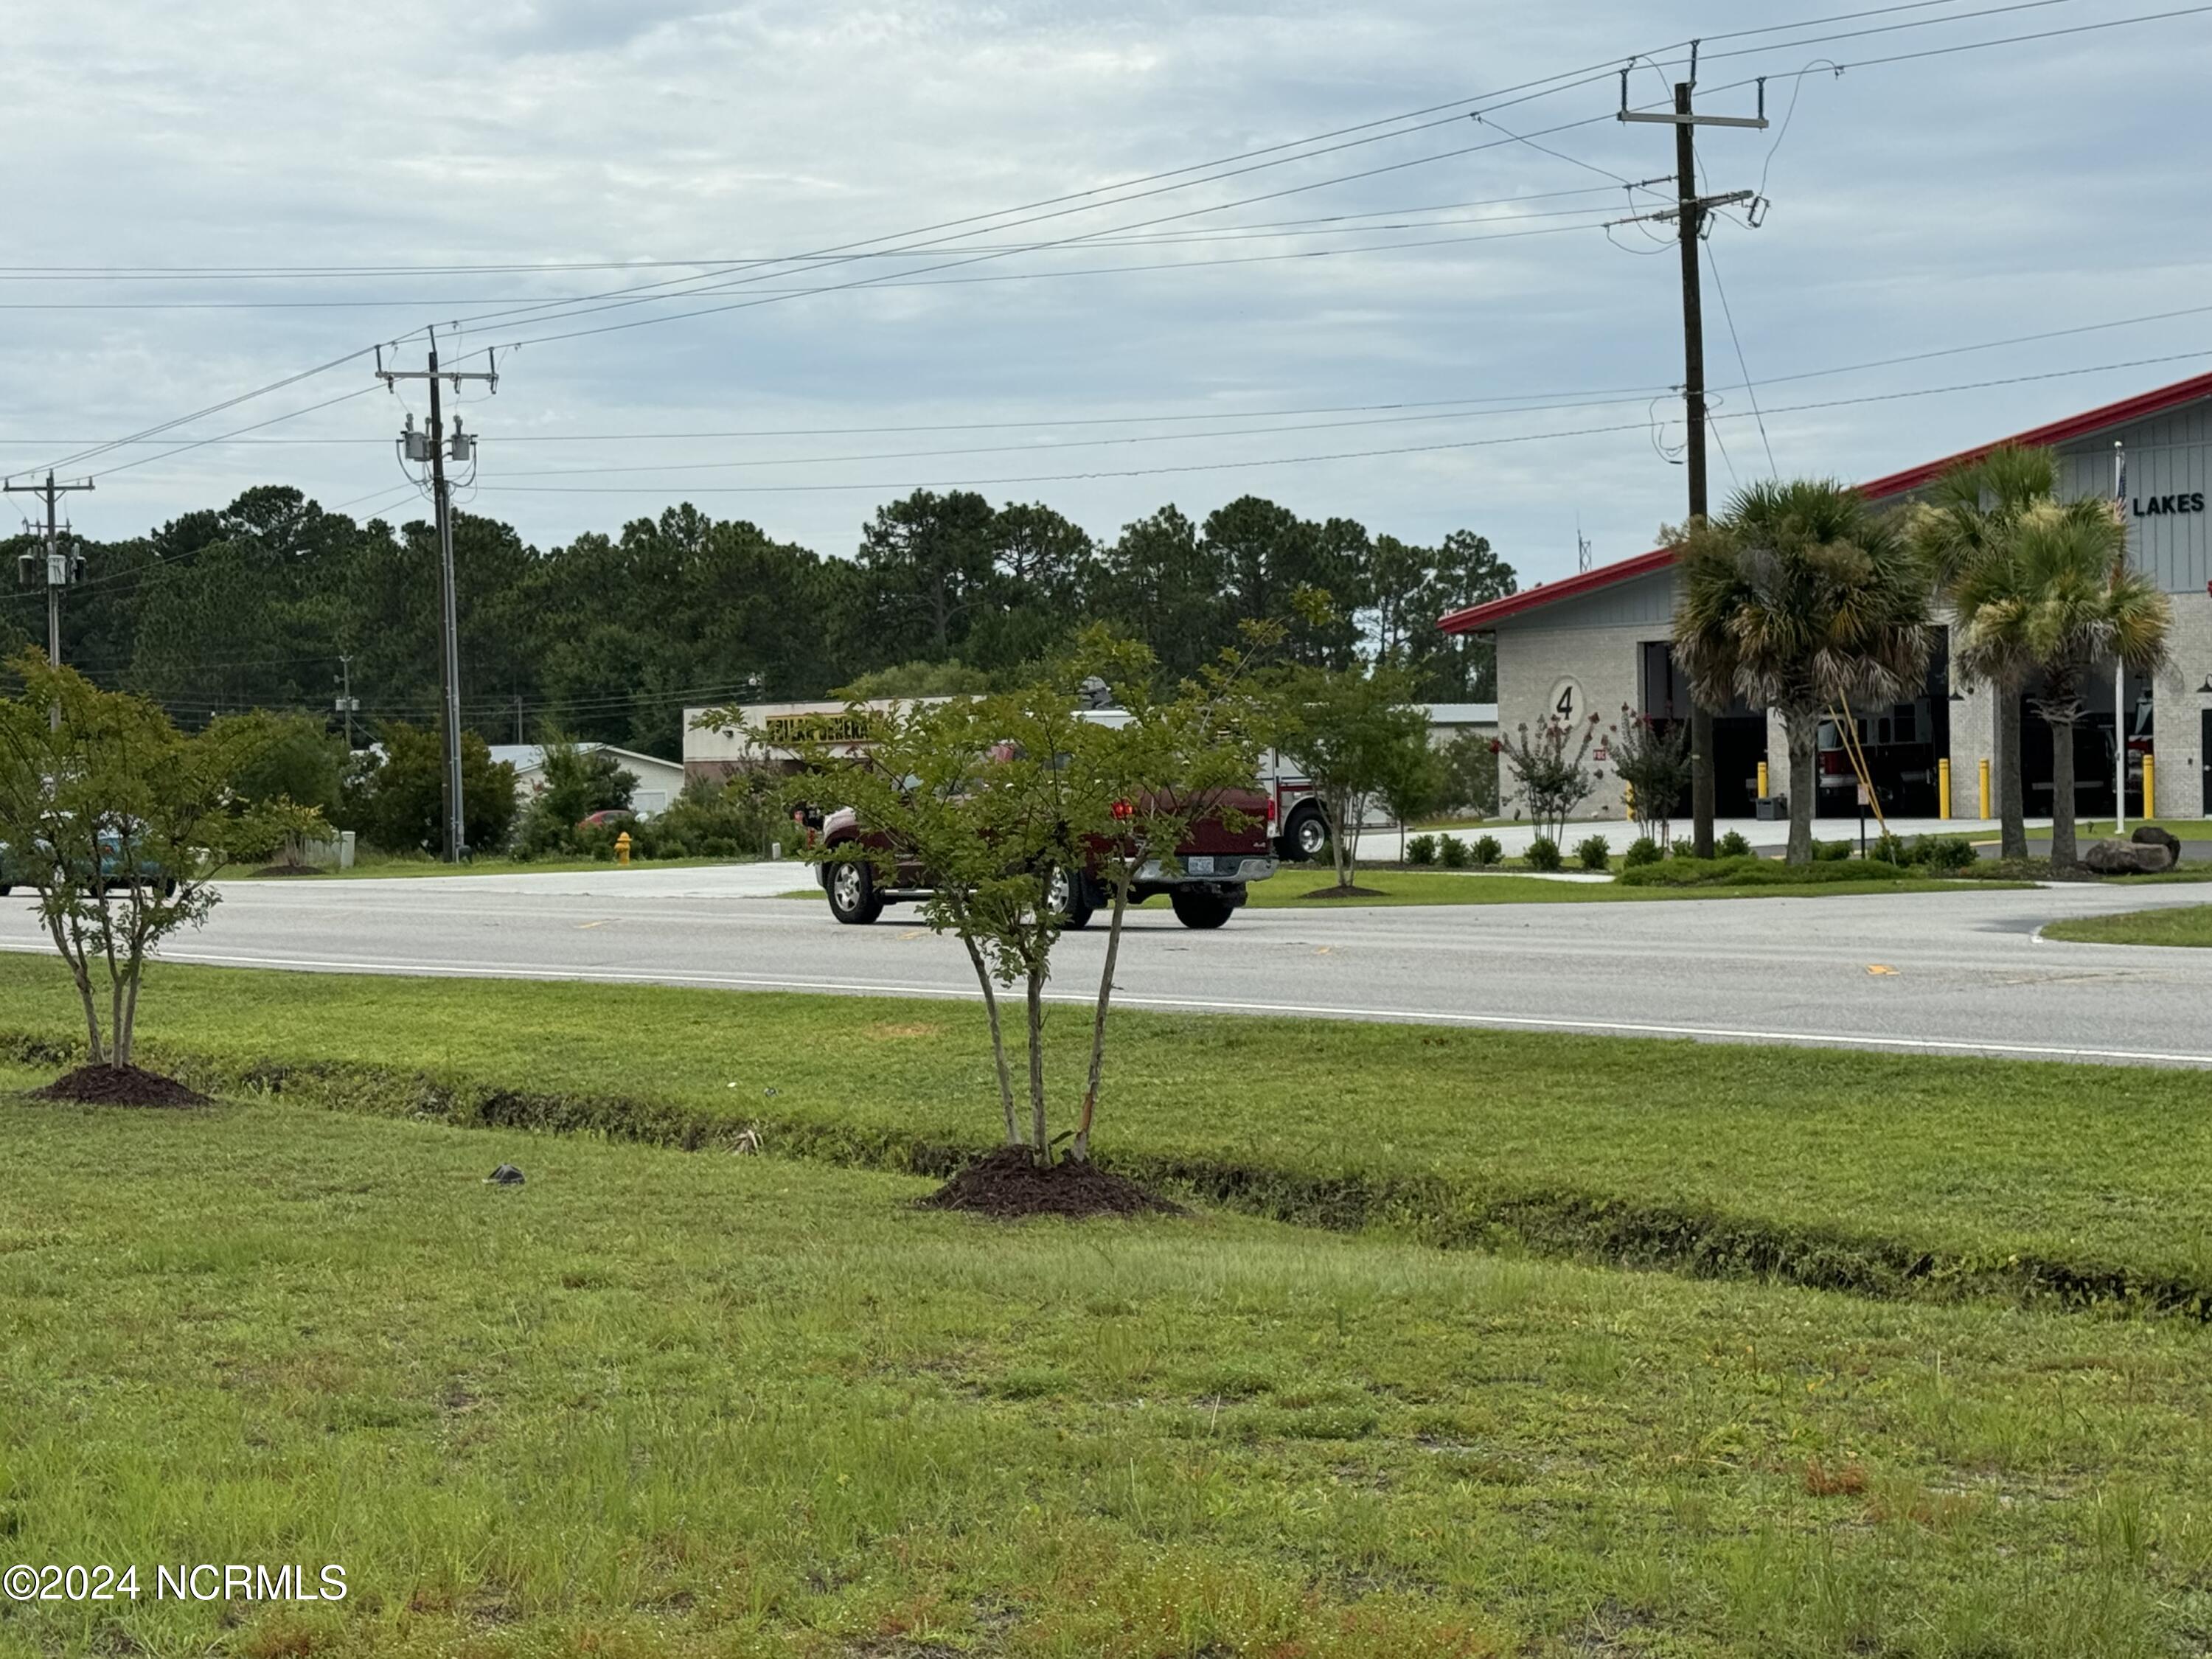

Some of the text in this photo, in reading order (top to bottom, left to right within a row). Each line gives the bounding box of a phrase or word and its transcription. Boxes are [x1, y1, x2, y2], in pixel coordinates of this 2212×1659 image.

[2133, 493, 2205, 517] LAKES
[1557, 686, 1573, 720] 4
[818, 716, 876, 740] GENERA
